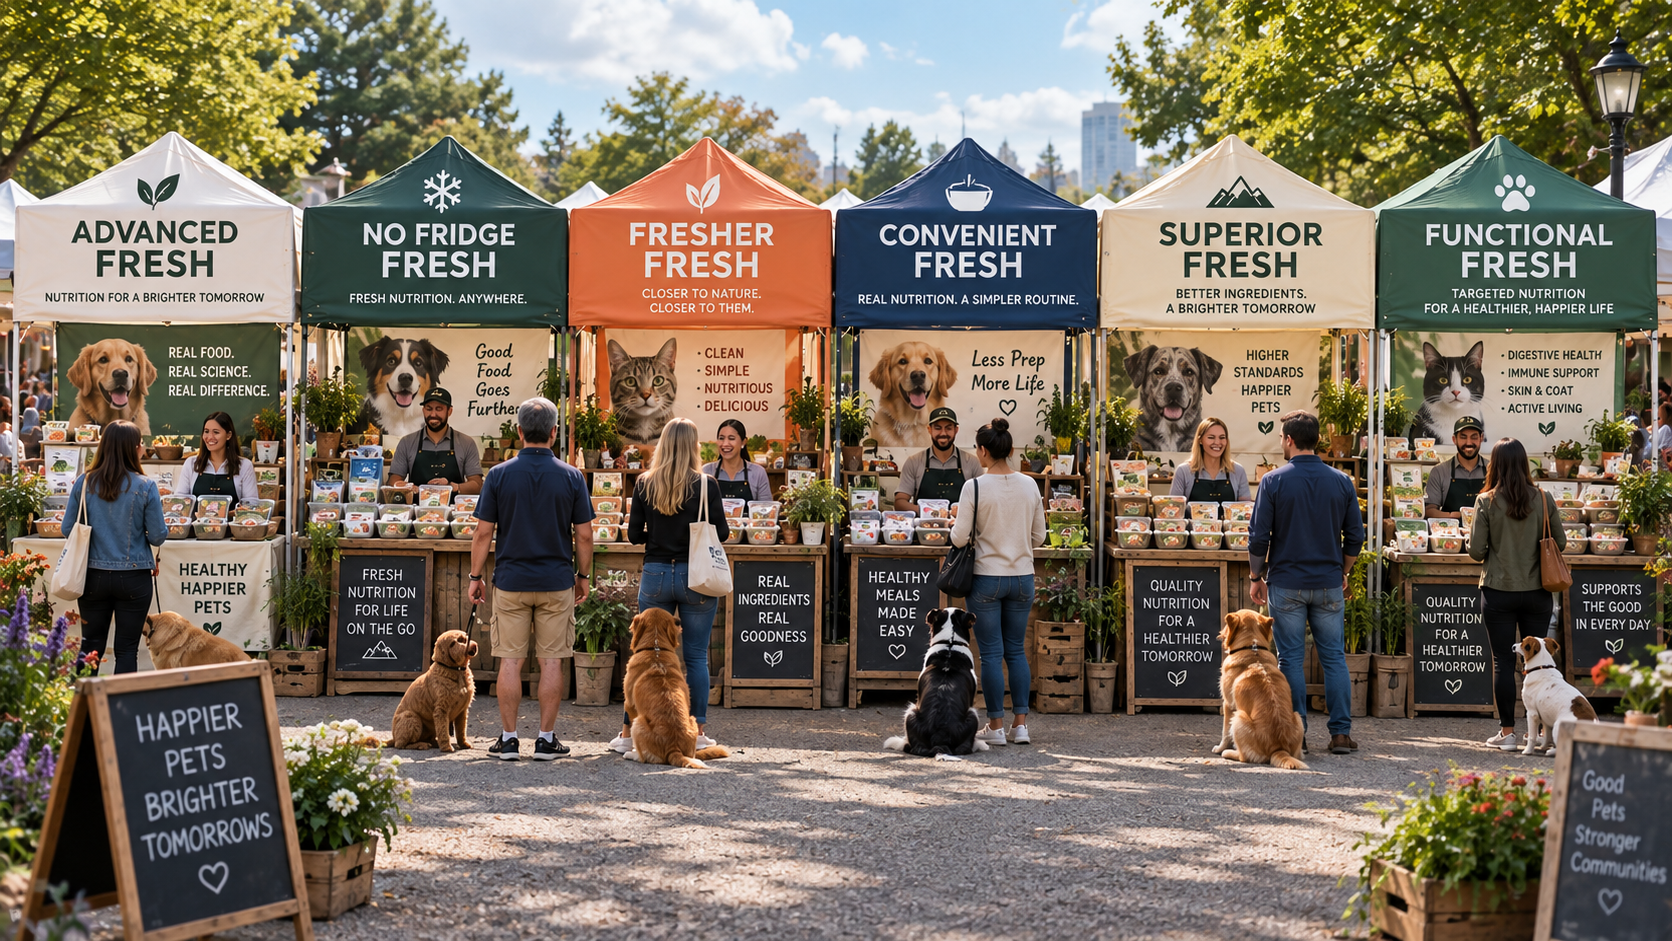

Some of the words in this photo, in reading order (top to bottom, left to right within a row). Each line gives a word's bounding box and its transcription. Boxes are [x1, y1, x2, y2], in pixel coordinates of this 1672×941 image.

[72, 220, 238, 244] ADVANCED
[363, 222, 408, 246] NO
[415, 222, 515, 246] FRIDGE
[629, 222, 775, 246] FRESHER
[879, 223, 1057, 247] CONVENIENT
[1159, 221, 1323, 247] SUPERIOR
[1426, 223, 1613, 247] FUNCTIONAL
[96, 249, 214, 278] FRESH
[382, 251, 496, 278] FRESH
[644, 251, 759, 279] FRESH
[914, 251, 1022, 279] FRESH
[1183, 251, 1297, 279] FRESH
[1461, 250, 1577, 279] FRESH
[45, 292, 105, 303] NUTRITION
[108, 292, 130, 303] FOR
[132, 292, 140, 303] A
[143, 292, 196, 303] BRIGHTER
[199, 292, 265, 303] TOMORROW
[349, 293, 386, 304] FRESH
[389, 293, 456, 304] NUTRITION.
[458, 293, 528, 304] ANYWHERE.
[642, 288, 688, 299] CLOSER
[691, 288, 709, 299] TO
[711, 288, 762, 299] NATURE.
[858, 293, 887, 305] REAL
[890, 293, 958, 305] NUTRITION.
[961, 294, 970, 305] A
[973, 294, 1022, 305] SIMPLER
[1025, 294, 1079, 306] ROUTINE.
[1176, 288, 1220, 299] BETTER
[1224, 288, 1307, 299] INGREDIENTS.
[1452, 288, 1514, 299] TARGETED
[1518, 288, 1586, 299] NUTRITION
[650, 303, 696, 314] CLOSER
[699, 303, 716, 313] TO
[719, 303, 755, 314] THEM.
[1165, 303, 1175, 314] A
[1178, 303, 1239, 314] BRIGHTER
[1242, 303, 1316, 314] TOMORROW
[1424, 303, 1448, 314] FOR
[1451, 303, 1460, 314] A
[1463, 303, 1532, 316] HEALTHIER,
[1535, 303, 1586, 314] HAPPIER
[1590, 303, 1614, 314] LIFE
[168, 347, 197, 359] REAL
[200, 347, 235, 359] FOOD.
[475, 343, 514, 359] Good
[704, 348, 744, 359] CLEAN
[1246, 349, 1289, 361] HIGHER
[1508, 350, 1559, 360] DIGESTIVE
[1562, 350, 1603, 361] HEALTH
[971, 350, 1006, 367] Less
[1010, 352, 1046, 371] Prep
[168, 366, 197, 378] REAL
[200, 366, 252, 378] SCIENCE.
[477, 362, 512, 378] Food
[704, 365, 749, 377] SIMPLE
[1234, 366, 1304, 378] STANDARDS
[1508, 367, 1549, 378] IMMUNE
[1552, 367, 1599, 379] SUPPORT
[476, 382, 510, 397] Goes
[704, 383, 773, 394] NUTRITIOUS
[971, 375, 1011, 391] More
[1016, 374, 1045, 393] Life
[1241, 384, 1291, 396] HAPPIER
[168, 385, 197, 397] REAL
[200, 385, 270, 397] DIFFERENCE.
[1507, 385, 1532, 396] SKIN
[1535, 385, 1543, 396] &
[1546, 385, 1574, 396] COAT
[704, 401, 769, 412] DELICIOUS
[1251, 401, 1281, 413] PETS
[1507, 403, 1545, 414] ACTIVE
[1548, 403, 1583, 414] LIVING
[180, 563, 248, 577] HEALTHY
[362, 568, 403, 581] FRESH
[758, 575, 790, 588] REAL
[868, 571, 930, 584] HEALTHY
[181, 582, 246, 595] HAPPIER
[348, 586, 416, 599] NUTRITION
[1150, 579, 1203, 593] QUALITY
[1581, 583, 1642, 596] SUPPORTS
[738, 593, 810, 606] INGREDIENTS
[876, 589, 920, 602] MEALS
[194, 601, 231, 614] PETS
[1143, 597, 1210, 610] NUTRITION
[1583, 601, 1605, 613] THE
[1608, 601, 1642, 613] GOOD
[355, 604, 380, 617] FOR
[383, 604, 408, 617] LIFE
[878, 607, 917, 619] MADE
[758, 612, 790, 624] REAL
[1158, 615, 1183, 627] FOR
[1186, 615, 1195, 627] A
[1420, 613, 1482, 624] NUTRITION
[1575, 618, 1587, 630] IN
[1590, 618, 1626, 631] EVERY
[1629, 618, 1651, 631] DAY
[346, 623, 365, 635] ON
[370, 623, 394, 635] THE
[397, 623, 416, 636] GO
[879, 625, 915, 637] EASY
[1435, 629, 1458, 640] FOR
[1461, 629, 1469, 640] A
[740, 630, 807, 643] GOODNESS
[1143, 632, 1210, 645] HEALTHIER
[1141, 650, 1214, 663] TOMORROW
[1422, 645, 1483, 657] HEALTHIER
[1419, 660, 1486, 673] TOMORROW
[135, 702, 243, 745] HAPPIER
[164, 742, 226, 778] PETS
[1582, 769, 1625, 794] Good
[144, 776, 259, 822] BRIGHTER
[1591, 798, 1626, 822] Pets
[140, 811, 274, 862] TOMORROWS
[1574, 824, 1641, 855] Stronger
[1570, 851, 1667, 885] Communities
